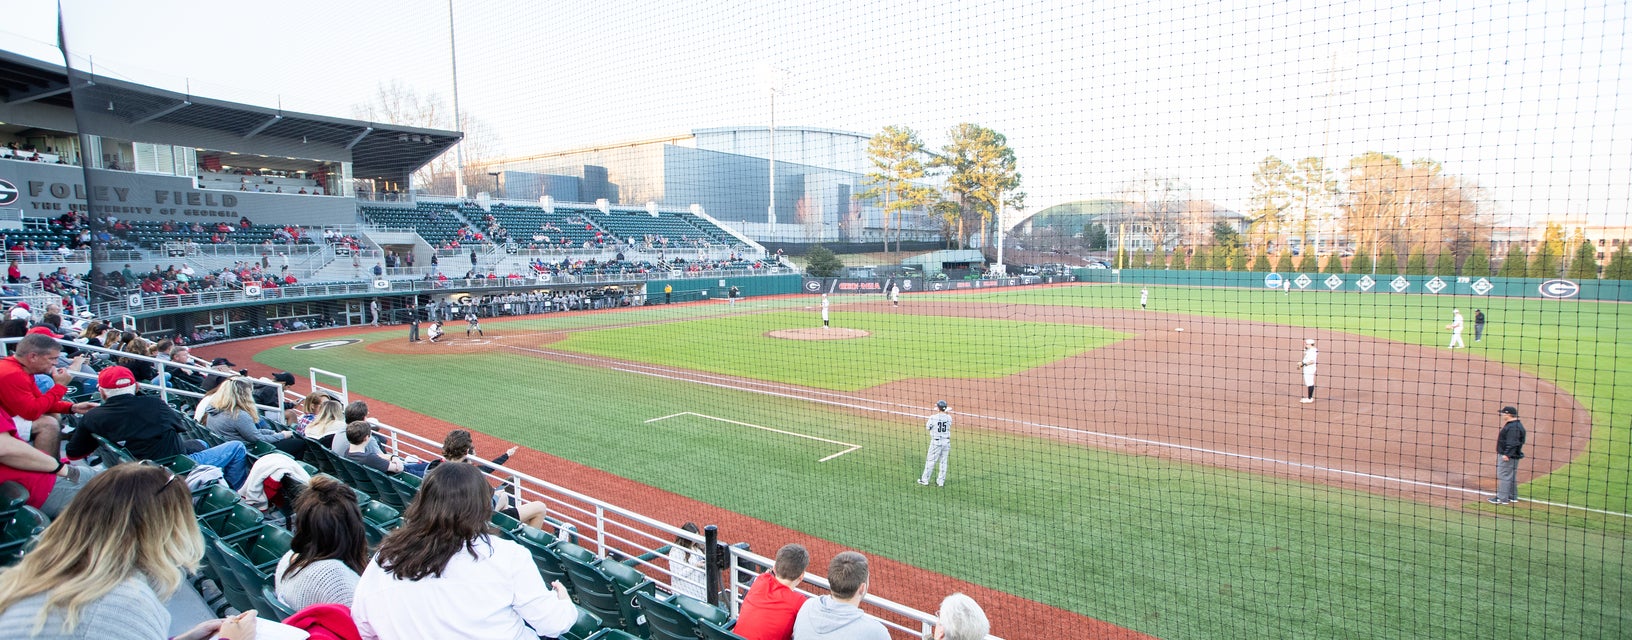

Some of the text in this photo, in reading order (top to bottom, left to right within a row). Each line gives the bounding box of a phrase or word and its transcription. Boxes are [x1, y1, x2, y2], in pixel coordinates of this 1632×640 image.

[28, 180, 129, 202] FOLEY
[155, 190, 238, 207] FIELD
[31, 202, 61, 210] THE
[69, 203, 152, 214] UNVERSITY
[184, 209, 239, 217] GEORGIA
[937, 421, 947, 432] 35
